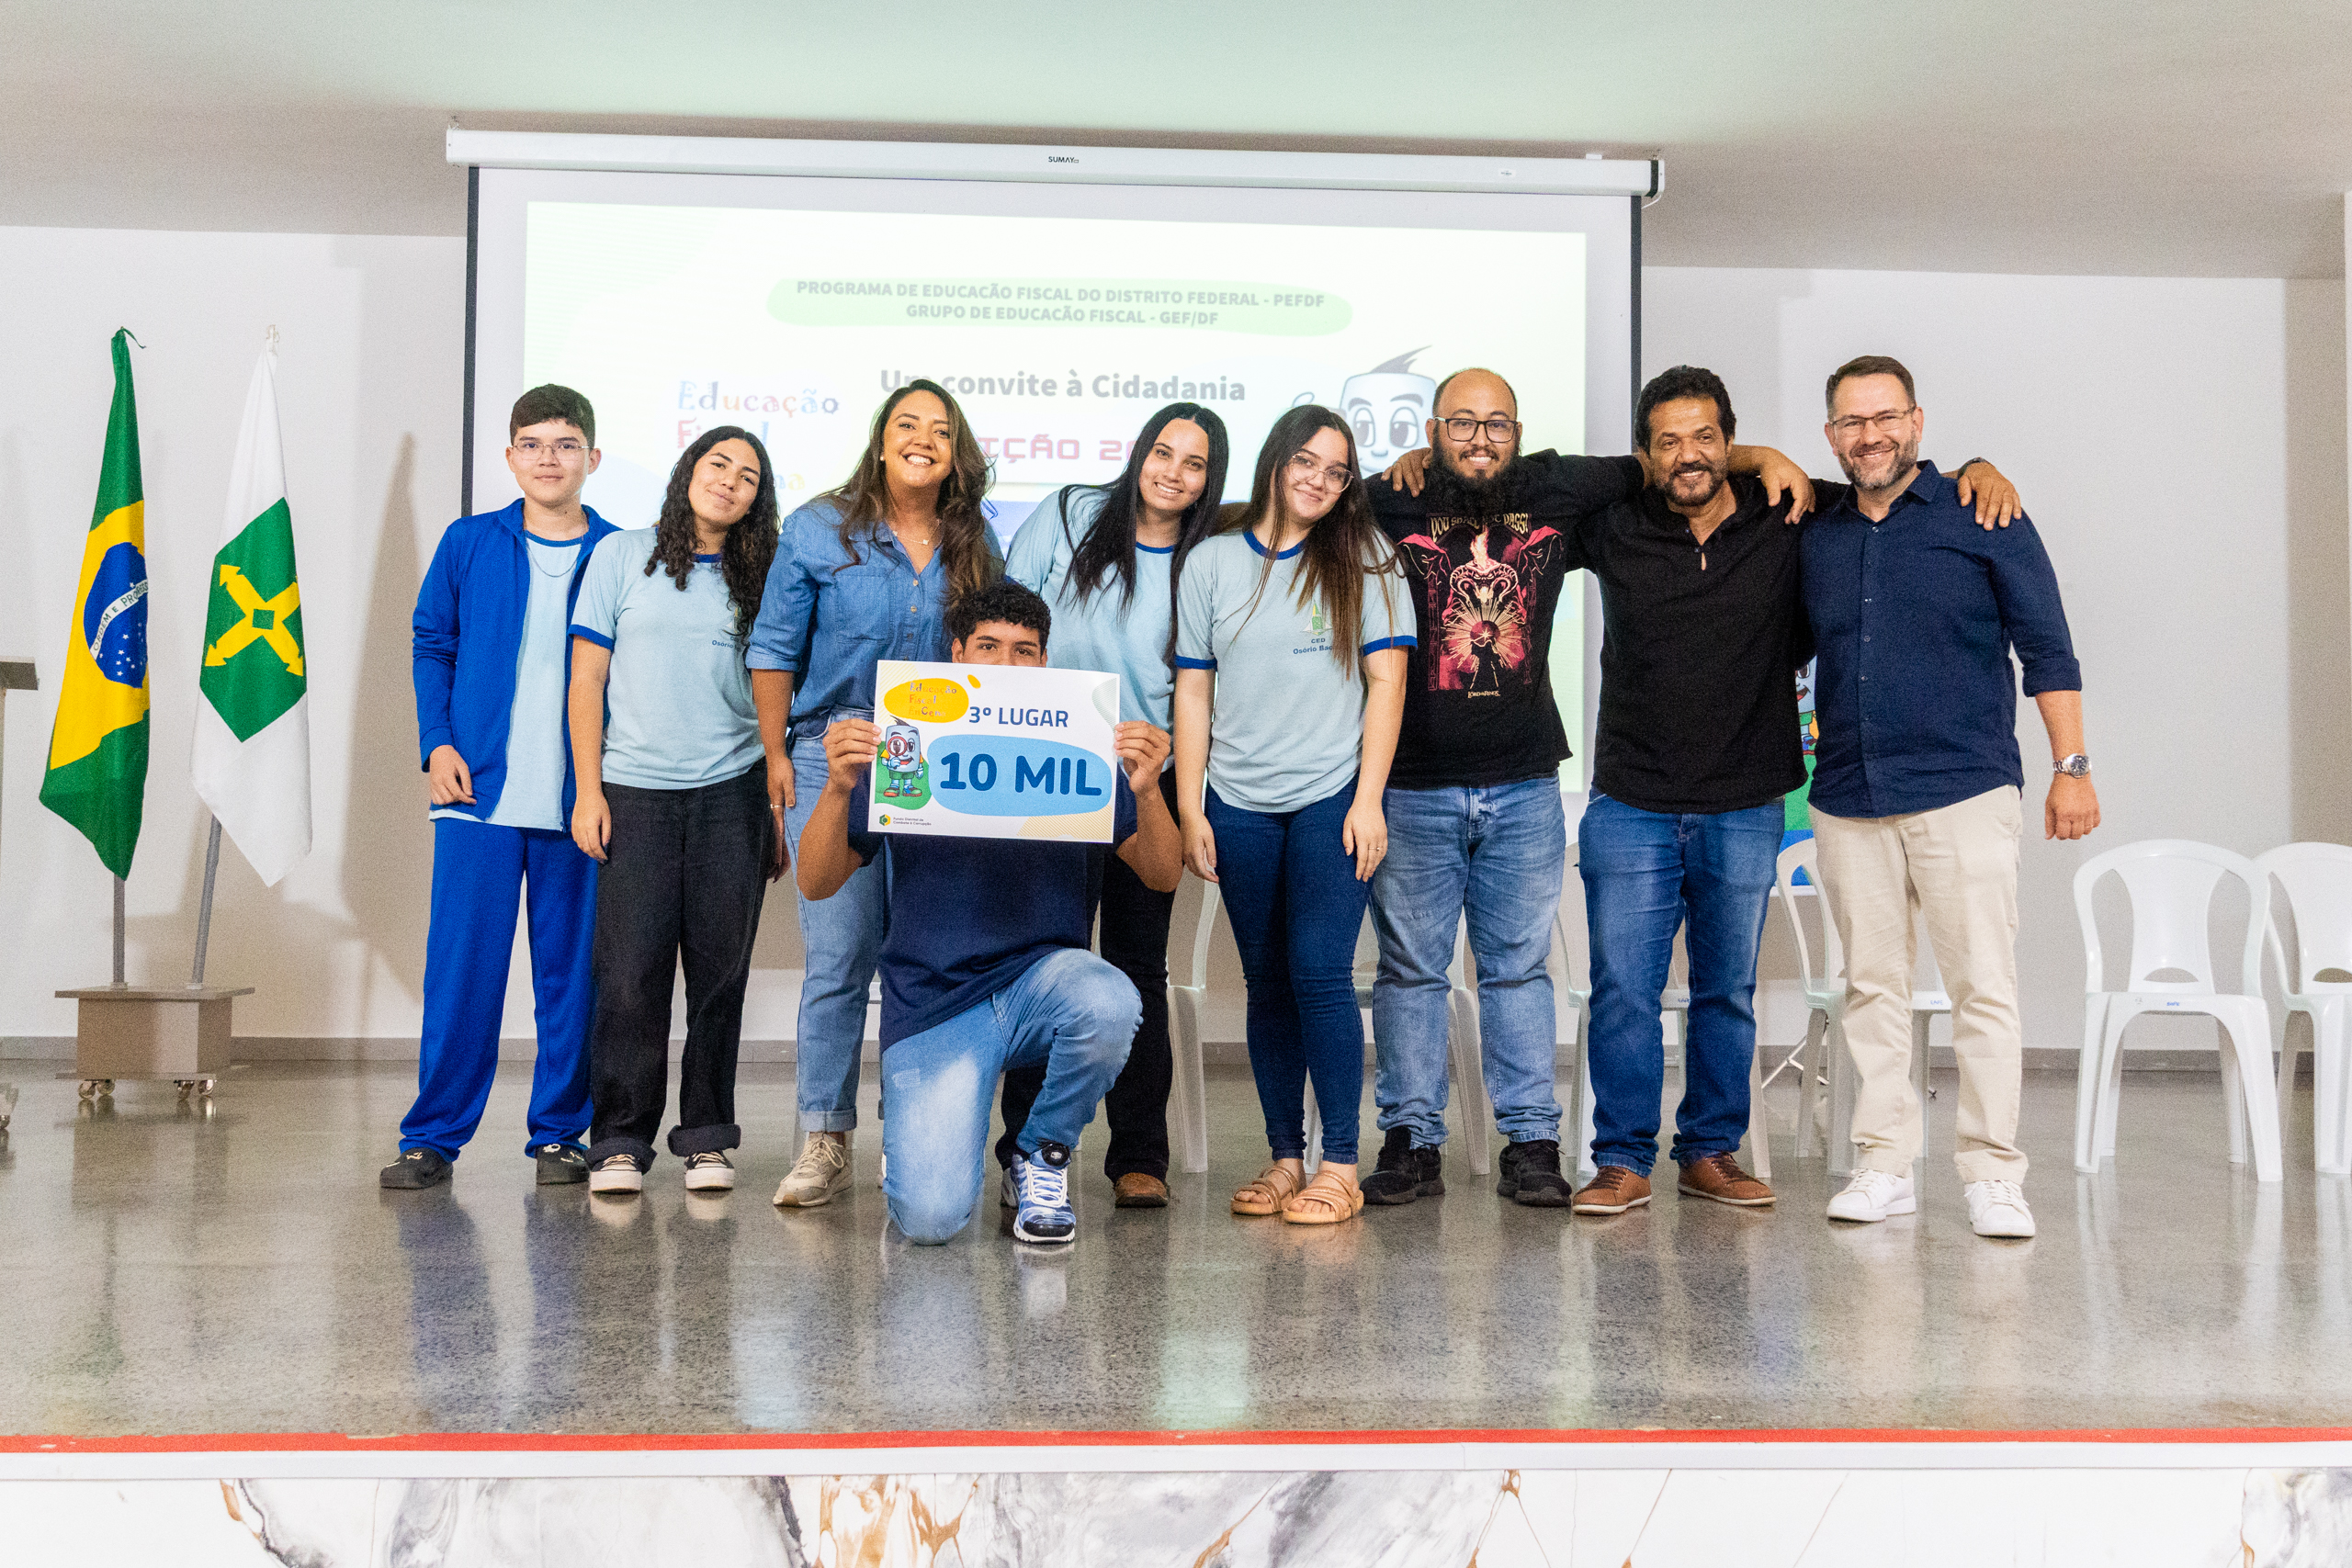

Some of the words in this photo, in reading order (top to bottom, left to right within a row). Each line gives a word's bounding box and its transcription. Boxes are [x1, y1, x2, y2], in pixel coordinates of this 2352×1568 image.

[1047, 155, 1075, 164] SUMAY
[797, 280, 893, 297] PROGRAMA
[897, 283, 918, 297] DE
[1017, 287, 1073, 301] FISCAL
[1078, 288, 1102, 302] DO
[1105, 289, 1183, 304] DISTRITO
[1187, 291, 1259, 306] FEDERAL
[1273, 294, 1325, 308] PEFDF
[906, 304, 967, 319] GRUPO
[970, 306, 991, 320] DE
[1090, 309, 1146, 323] FISCAL
[1159, 310, 1219, 328] GEF/DF
[941, 370, 1057, 398] convite
[1067, 369, 1083, 397] à
[1092, 374, 1246, 400] Cidadania
[677, 380, 840, 418] Educação
[975, 434, 1080, 464] IÇÃO
[93, 613, 112, 651] ORDEM
[111, 605, 119, 614] E
[712, 639, 733, 649] Osório
[1293, 646, 1317, 655] Osório
[909, 694, 937, 705] Fiscal
[910, 682, 957, 695] Educação
[968, 706, 992, 724] 3º
[998, 707, 1069, 728] LUGAR
[940, 751, 998, 792] 10
[1014, 755, 1102, 796] MIL
